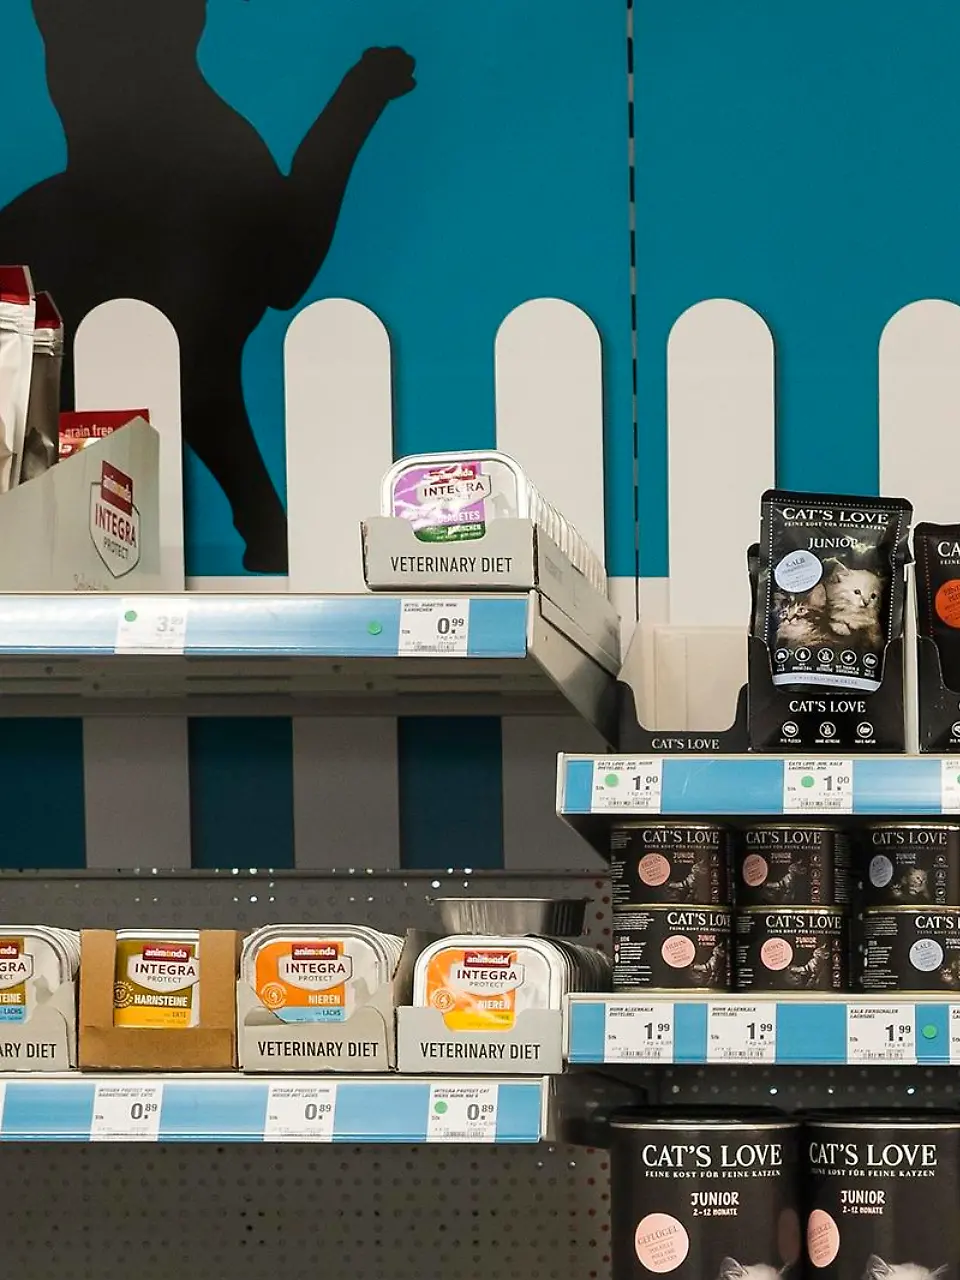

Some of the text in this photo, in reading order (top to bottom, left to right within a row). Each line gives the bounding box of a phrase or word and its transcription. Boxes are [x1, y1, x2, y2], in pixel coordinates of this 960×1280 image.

[65, 425, 113, 438] grain free
[424, 483, 484, 496] INTEGRA
[783, 507, 889, 525] CAT'S LOVE
[95, 503, 136, 548] INTEGRA
[391, 557, 512, 572] VETERINARY DIET
[789, 701, 866, 712] CAT'S LOVE
[652, 738, 720, 750] CAT'S LOVE
[643, 831, 719, 845] CAT'S LOVE
[766, 915, 841, 929] CAT'S LOVE
[145, 948, 186, 958] animonda
[294, 947, 336, 957] animonda
[135, 963, 195, 976] INTEGRA
[285, 962, 346, 974] INTEGRA
[457, 969, 517, 981] INTEGRA
[135, 994, 188, 1006] HARNSTEINE
[308, 995, 341, 1005] NIEREN
[258, 1041, 378, 1057] VETERINARY DIET
[421, 1042, 540, 1059] VETERINARY DIET
[642, 1144, 782, 1167] CAT'S LOVE
[809, 1142, 937, 1167] CAT'S LOVE
[691, 1192, 739, 1206] JUNIOR
[841, 1190, 885, 1205] JUNIOR
[693, 1208, 711, 1216] 2-12
